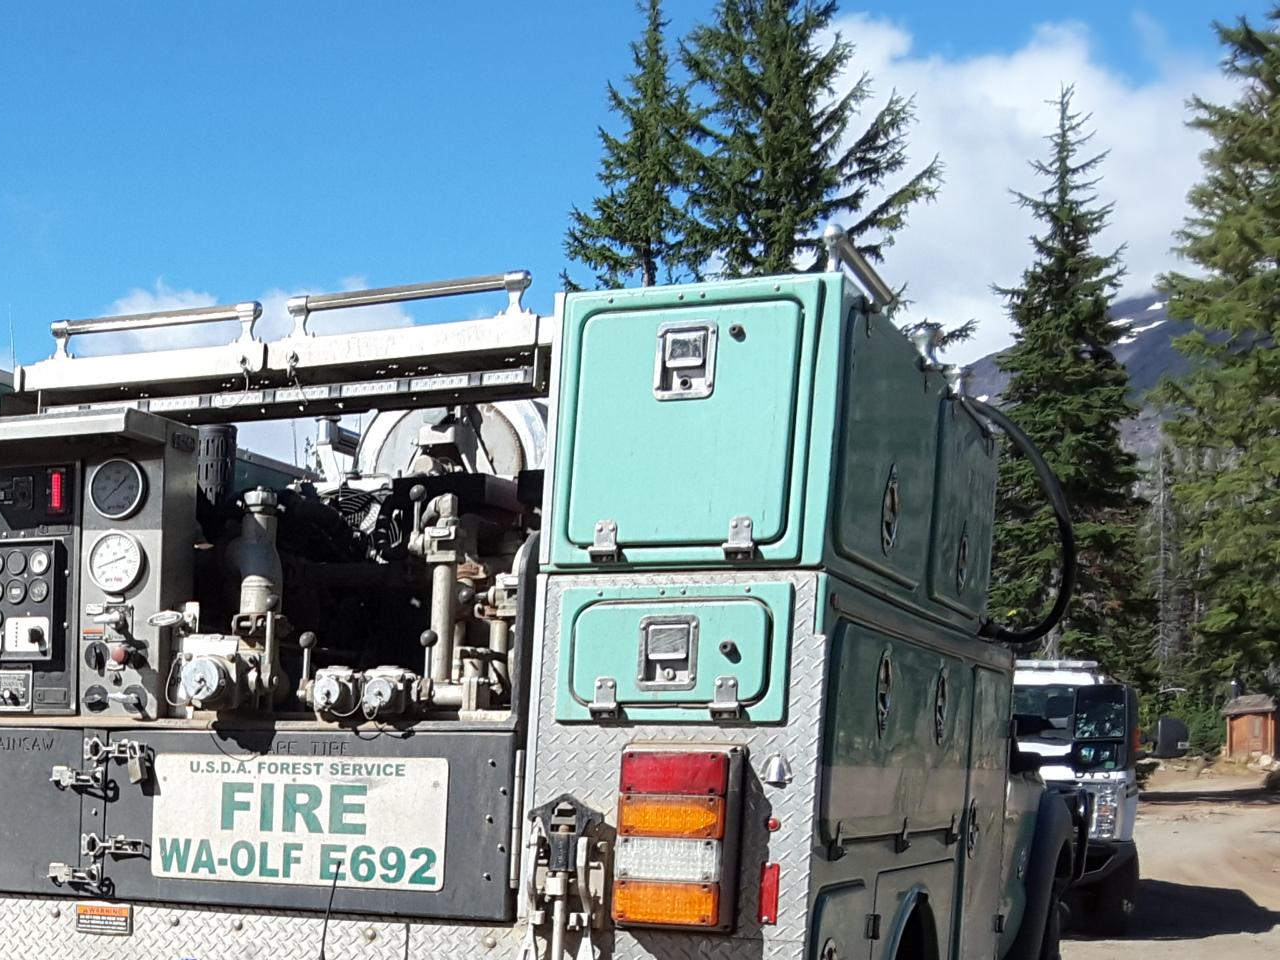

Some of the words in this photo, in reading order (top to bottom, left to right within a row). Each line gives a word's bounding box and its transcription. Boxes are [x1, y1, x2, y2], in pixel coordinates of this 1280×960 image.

[189, 760, 251, 775] U.S.D.A.
[257, 762, 324, 776] FOREST
[329, 763, 406, 777] SERVICE
[220, 781, 368, 835] FIRE
[158, 837, 303, 879] WA-OLF
[319, 843, 437, 886] E692
